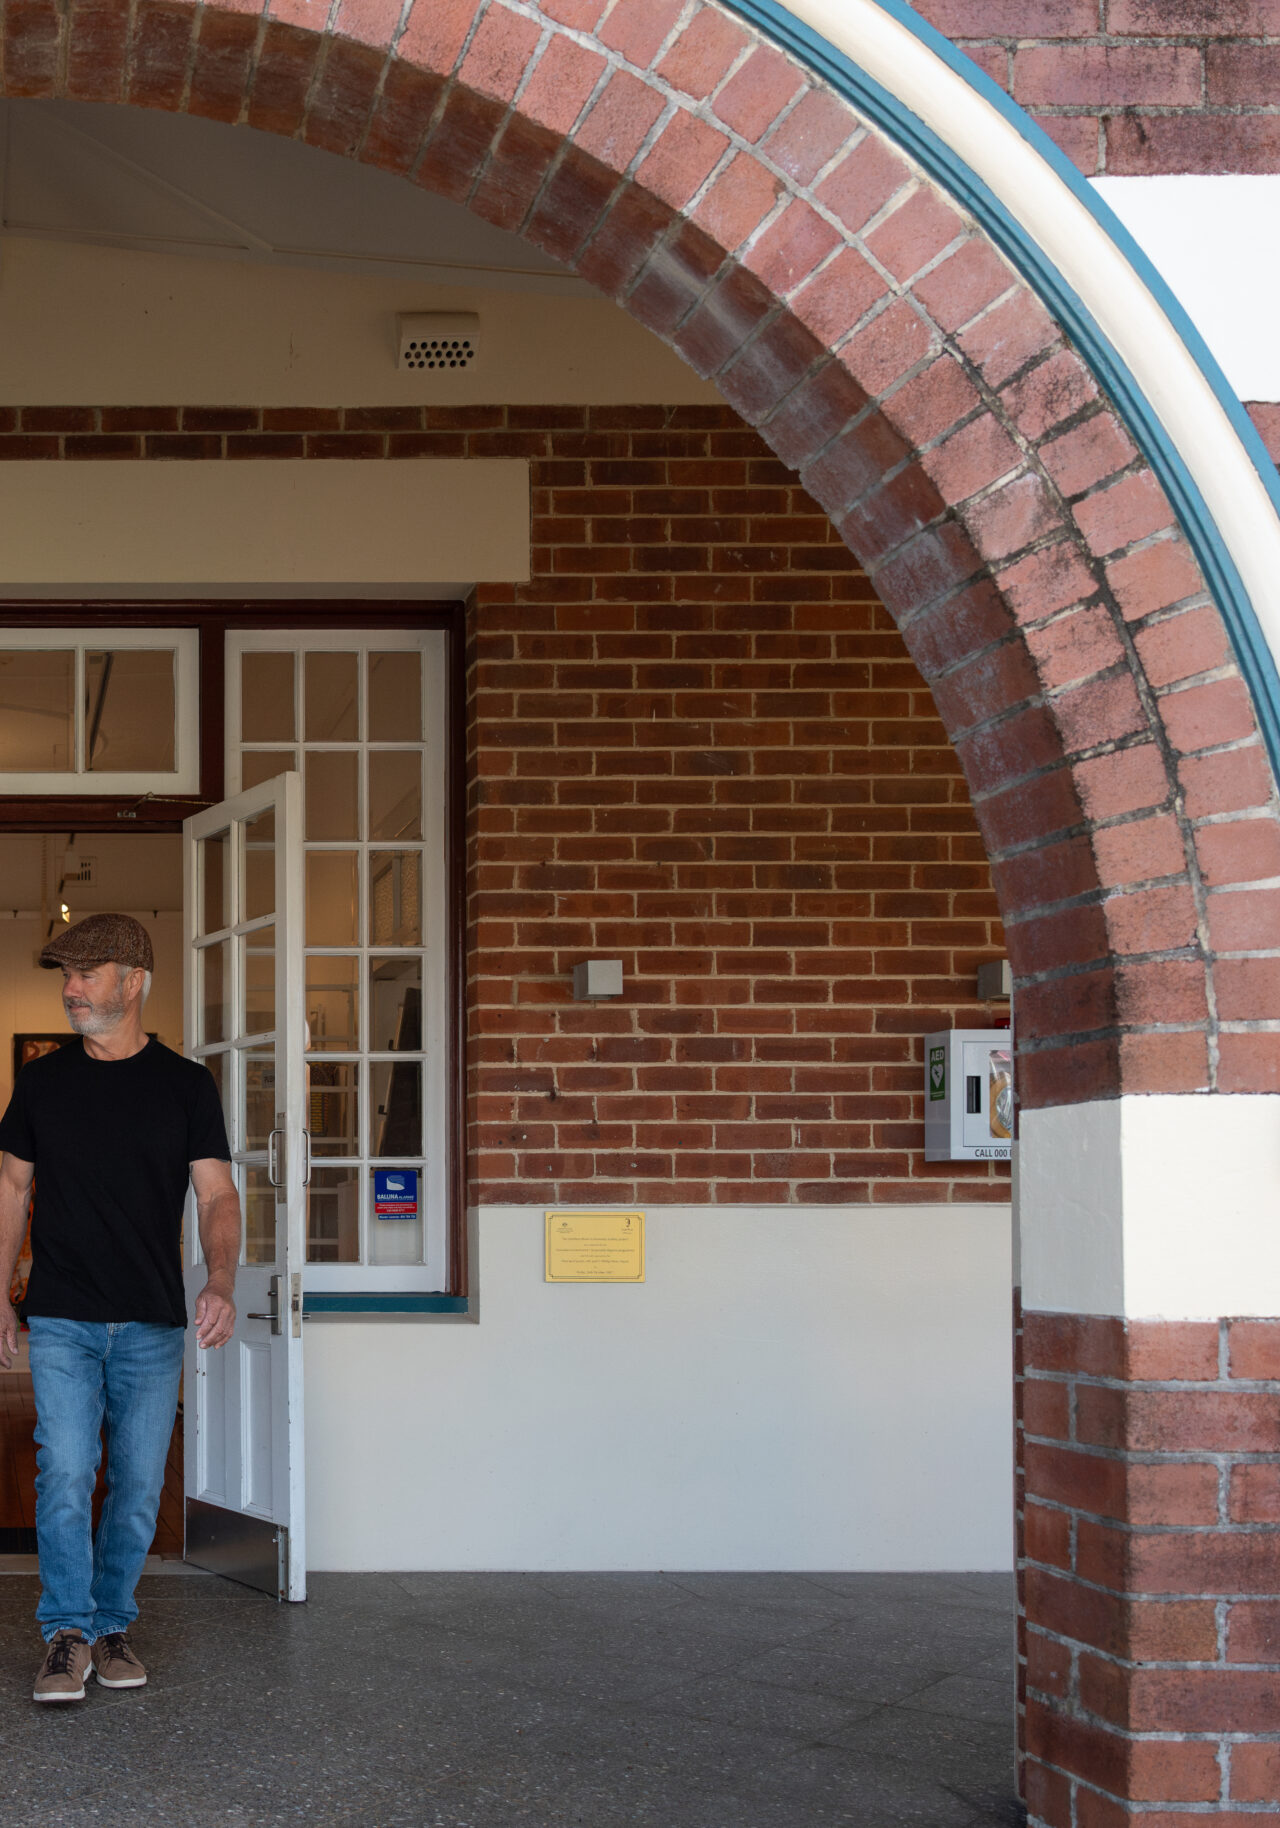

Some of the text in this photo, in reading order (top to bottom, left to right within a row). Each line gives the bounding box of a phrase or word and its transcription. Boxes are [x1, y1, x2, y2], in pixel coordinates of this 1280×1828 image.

[931, 1049, 944, 1062] AED
[974, 1149, 993, 1158] CALL
[994, 1149, 1008, 1158] 000
